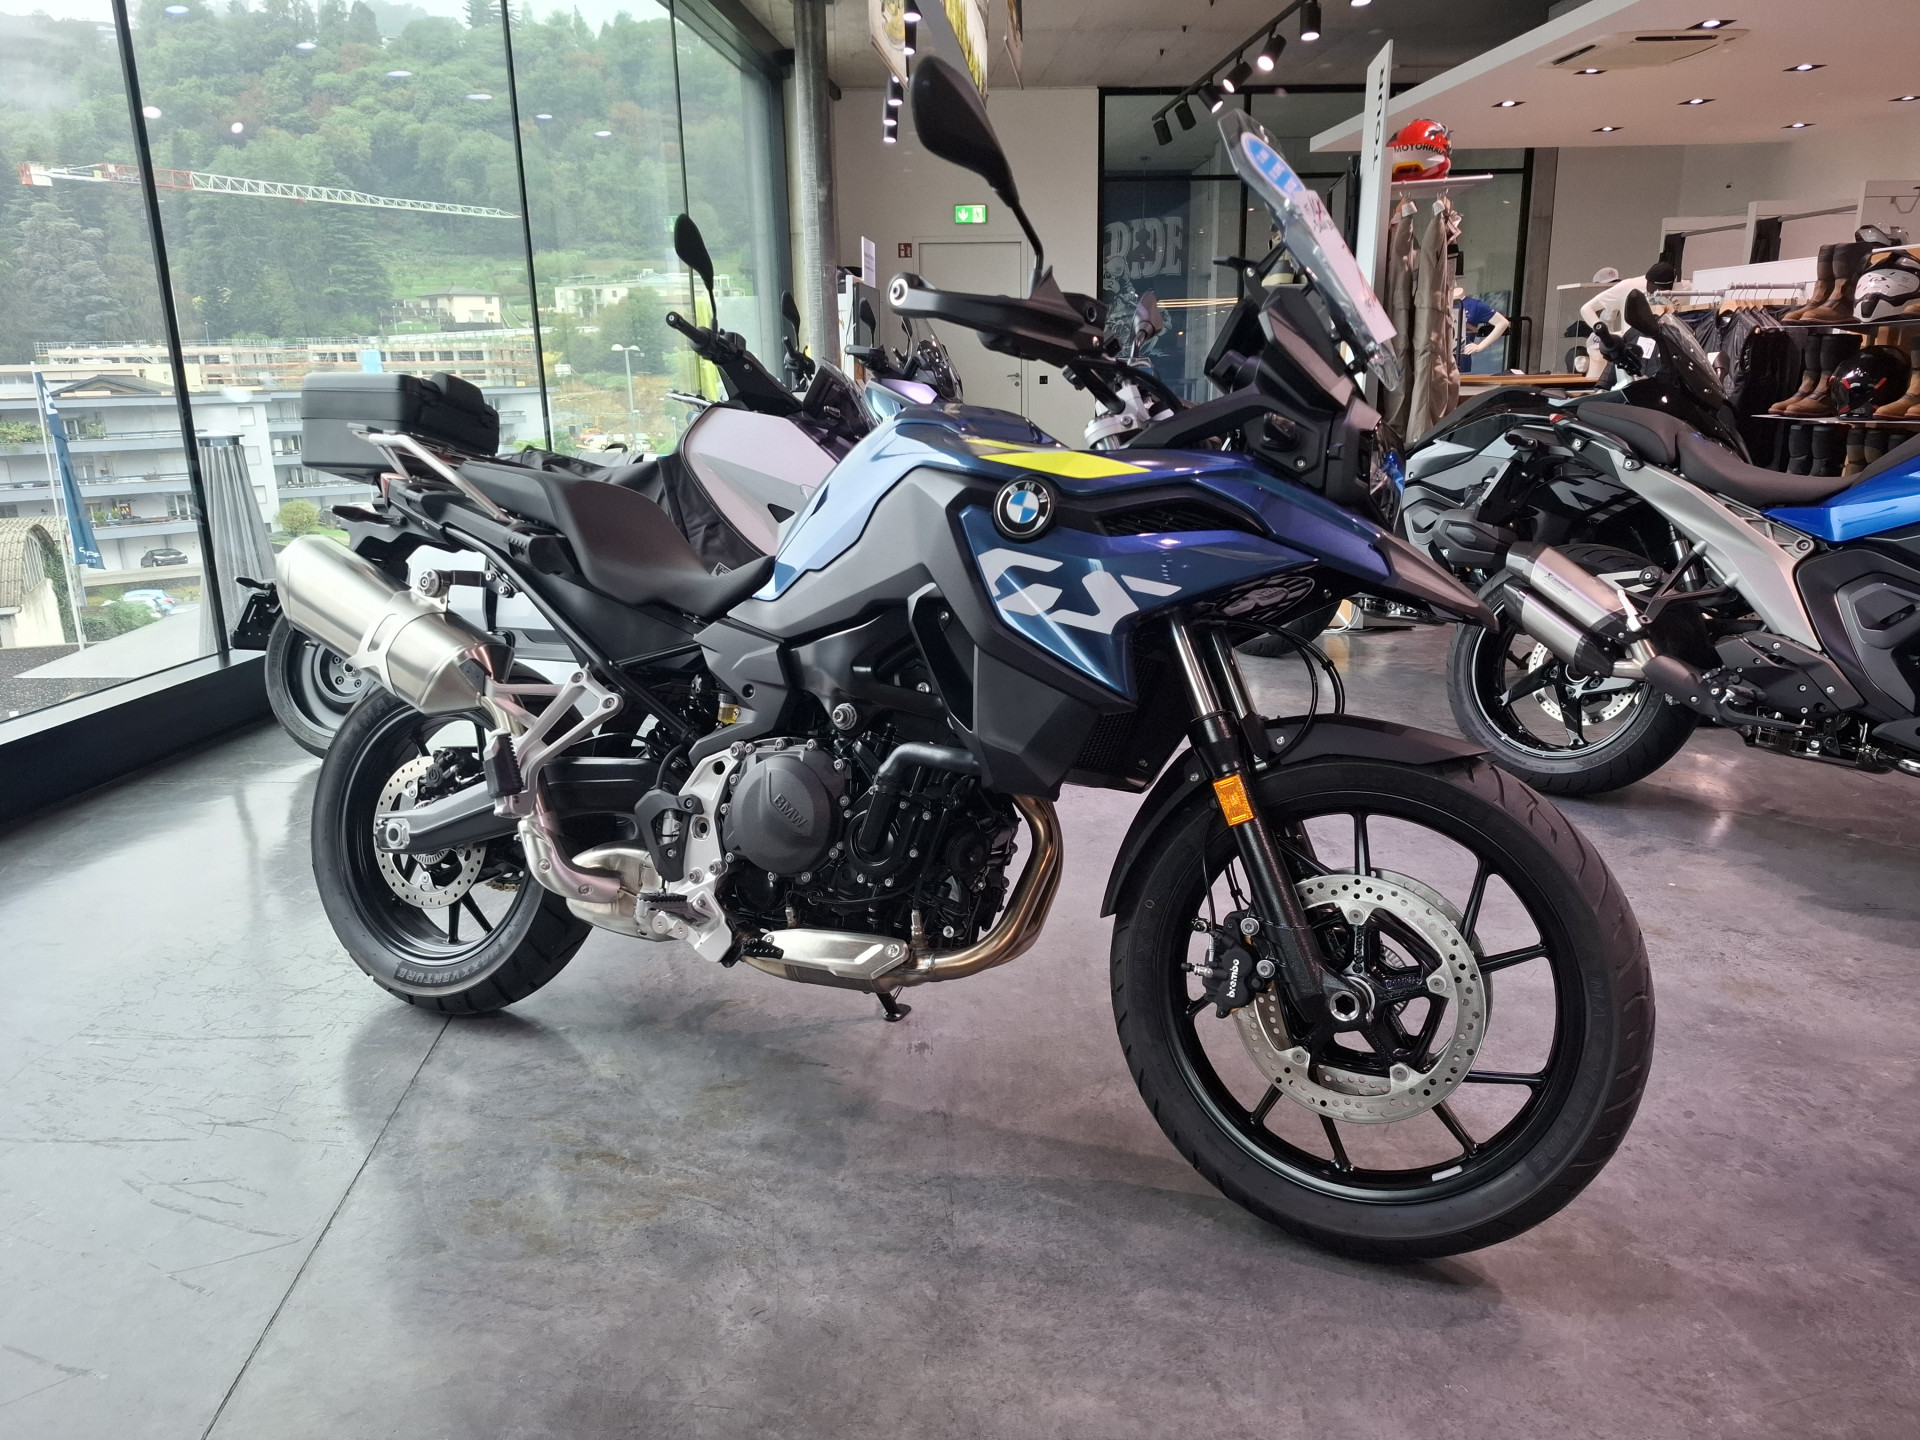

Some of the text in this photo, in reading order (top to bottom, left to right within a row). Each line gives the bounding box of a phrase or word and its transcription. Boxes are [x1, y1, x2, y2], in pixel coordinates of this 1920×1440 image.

[1394, 143, 1444, 155] MOTORRAD
[1008, 481, 1048, 503] BMW
[773, 793, 808, 828] BMW
[1226, 958, 1240, 998] brembo
